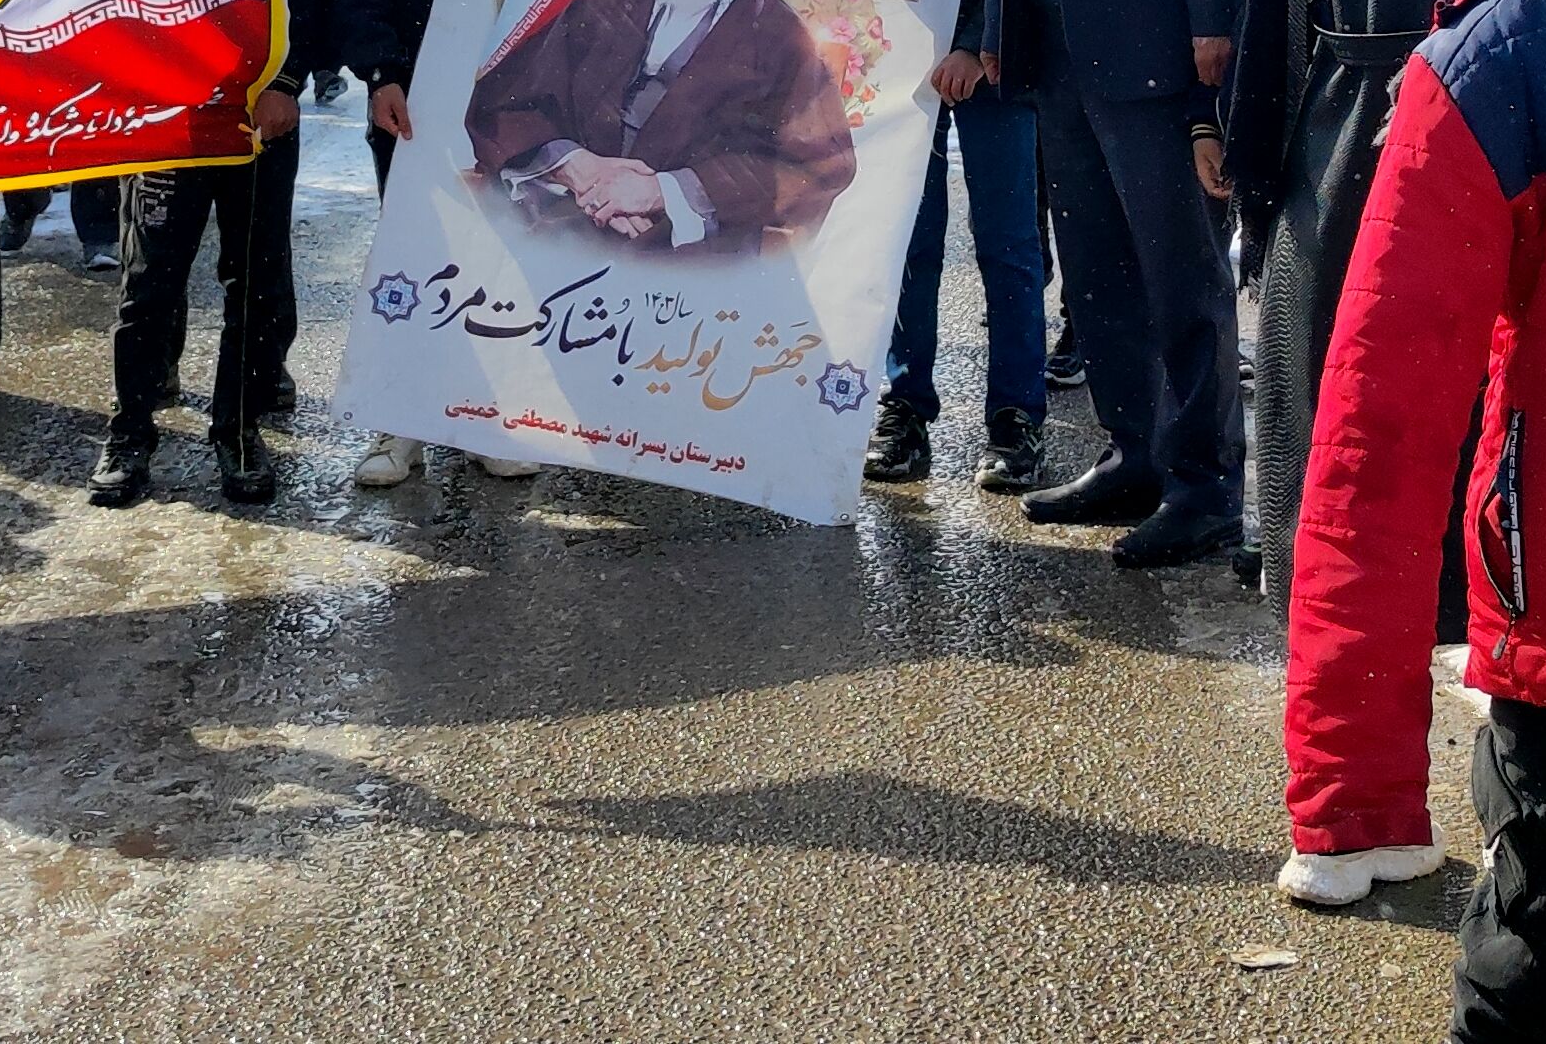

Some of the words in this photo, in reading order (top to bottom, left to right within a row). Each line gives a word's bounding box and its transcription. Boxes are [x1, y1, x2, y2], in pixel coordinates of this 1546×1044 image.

[424, 263, 486, 330] مردم
[463, 265, 621, 353] مشارکت
[655, 292, 693, 325] سال
[612, 317, 635, 387] با
[635, 308, 740, 395] تولید
[702, 320, 822, 411] جهش
[444, 399, 500, 420] خمینی
[503, 408, 568, 434] مصطفی
[572, 424, 612, 445] شهید
[615, 431, 667, 462] پسرانه
[669, 441, 746, 472] دبیرستان
